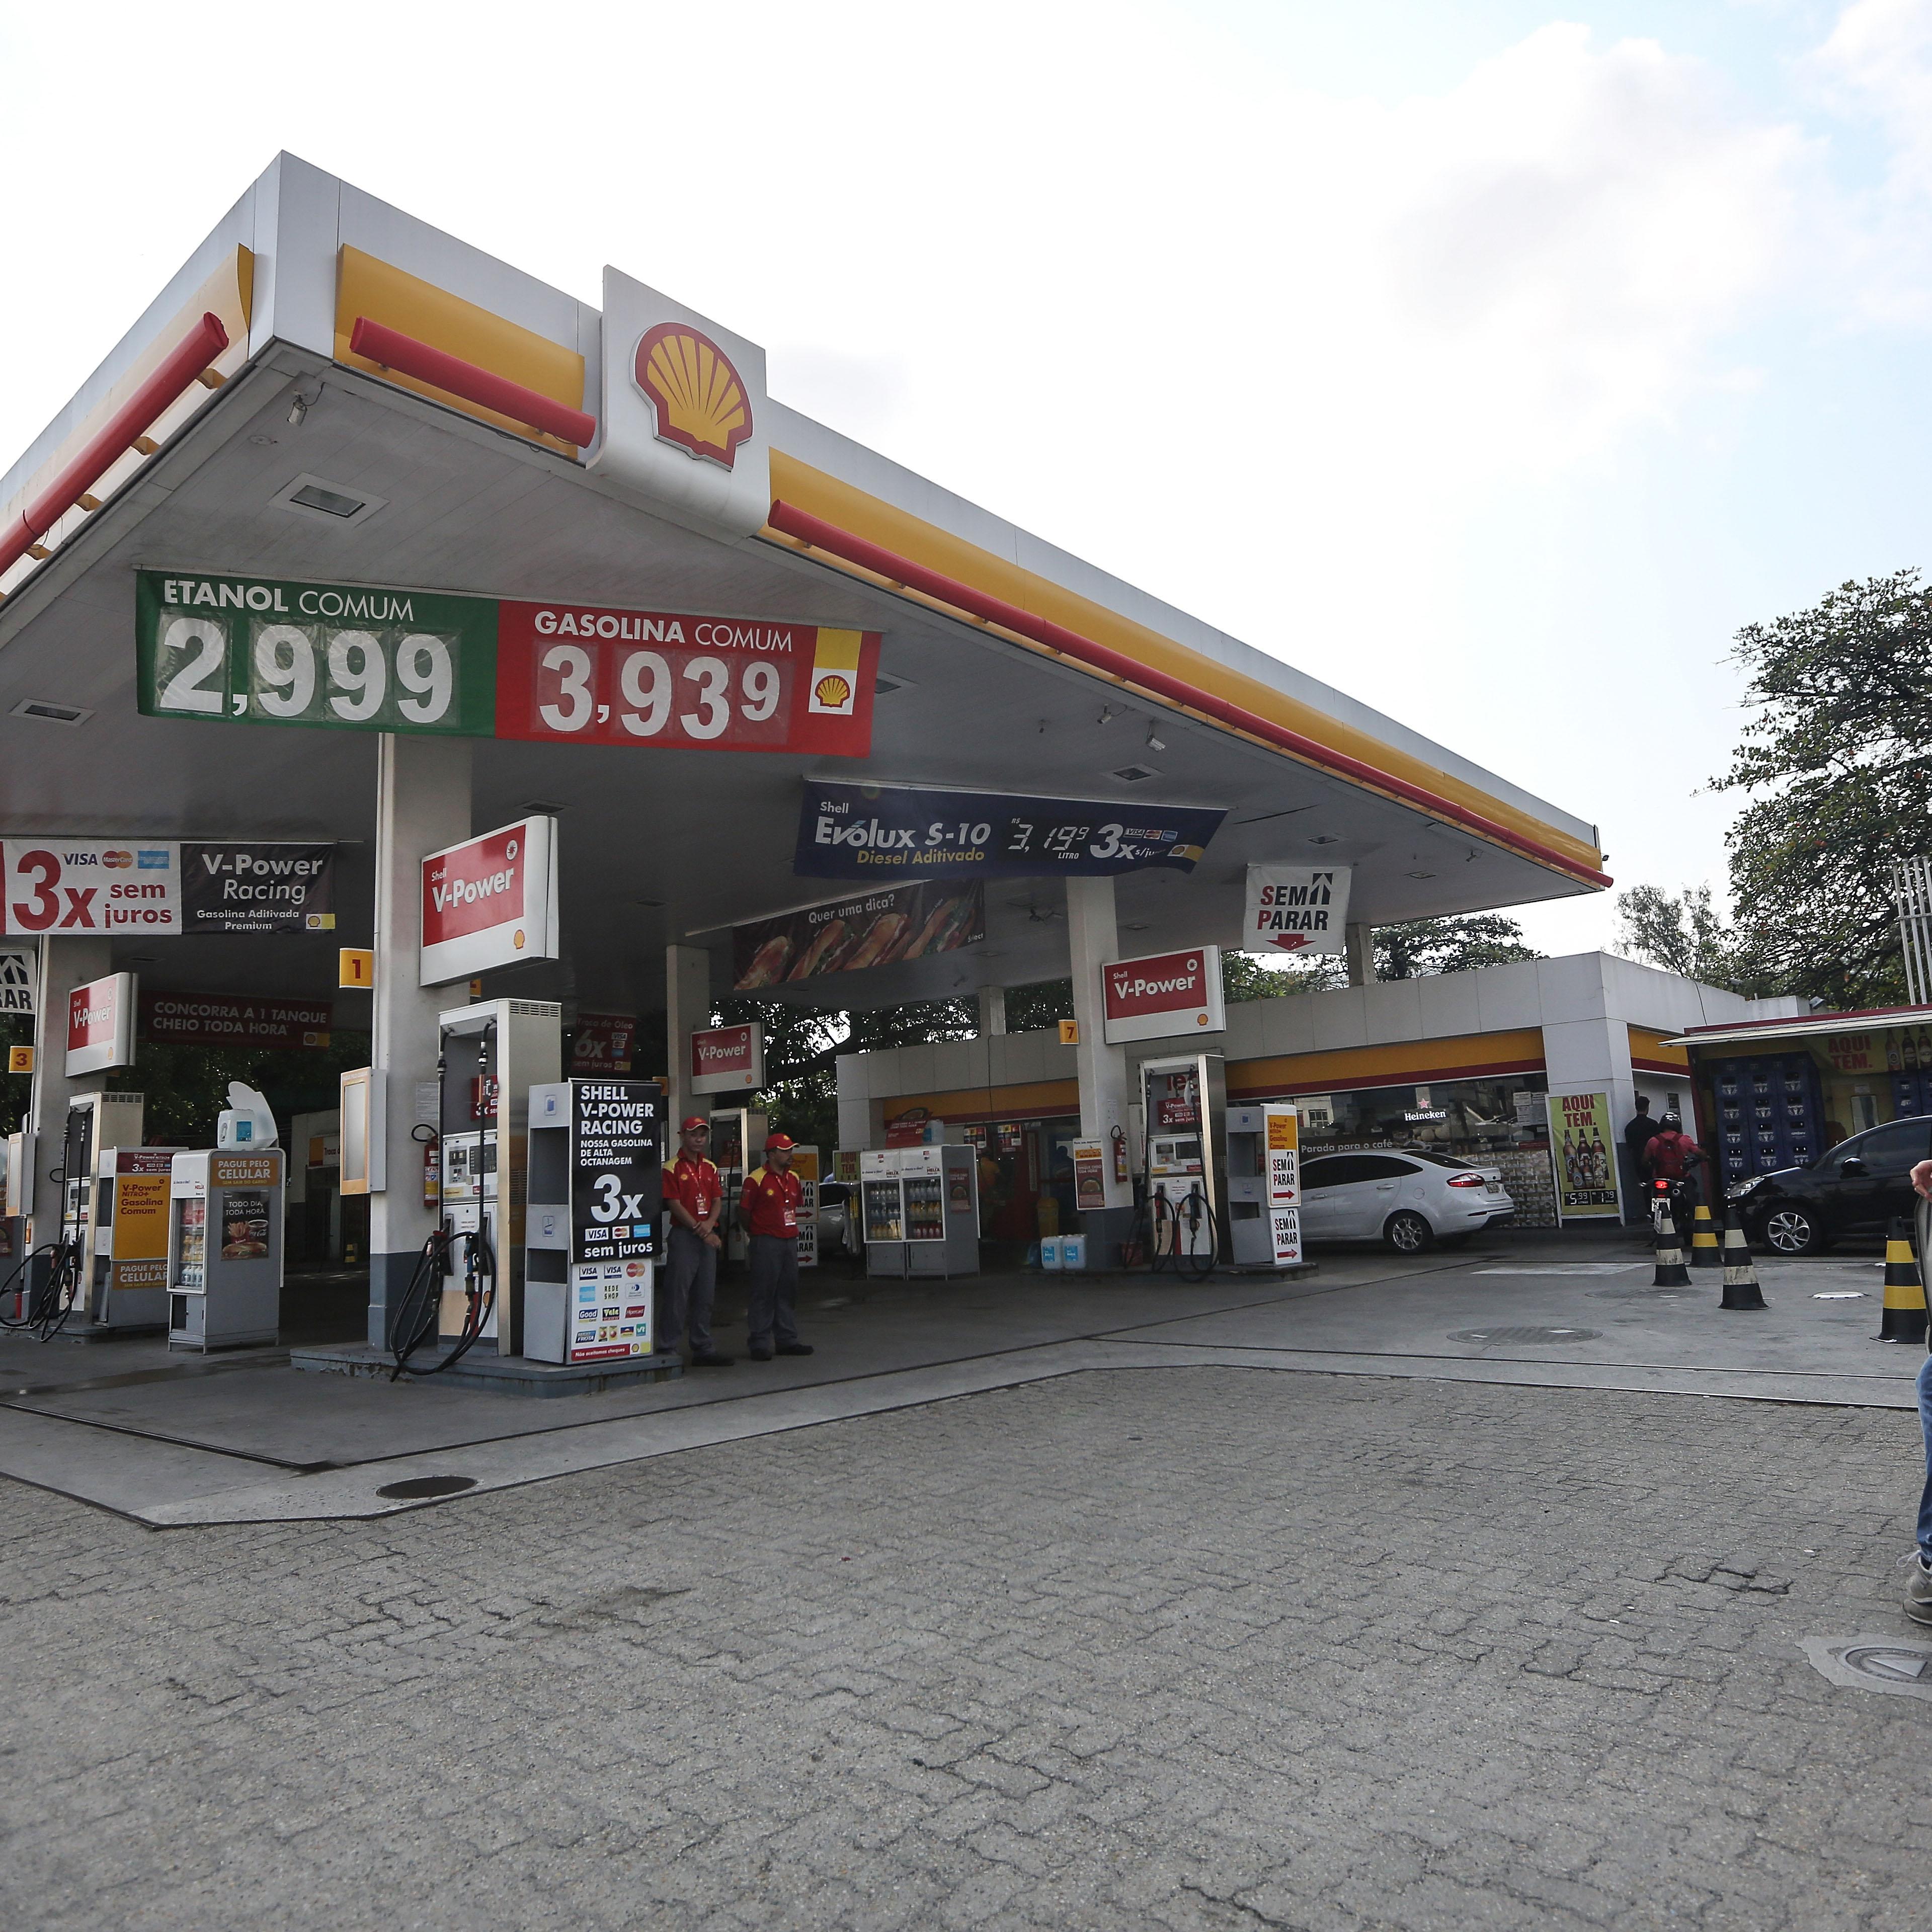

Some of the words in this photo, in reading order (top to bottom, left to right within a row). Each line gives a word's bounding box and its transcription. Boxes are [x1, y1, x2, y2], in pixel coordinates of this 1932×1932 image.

[164, 580, 288, 612] ETANOL
[299, 590, 414, 621] COMUM
[535, 611, 685, 643] GASOLINA
[695, 624, 792, 652] COMUM
[159, 617, 452, 723] 2,999
[539, 645, 780, 740] 3,939
[820, 801, 848, 813] Shell
[925, 823, 991, 845] S-10
[1090, 824, 1137, 859] 3x
[62, 853, 98, 865] VISA
[857, 849, 908, 864] Diesel
[912, 847, 985, 864] Aditivado
[202, 854, 323, 875] V-Power
[431, 867, 447, 881] Shell
[13, 849, 98, 931] 3x
[110, 884, 166, 899] sem
[223, 879, 306, 905] Racing
[432, 867, 514, 912] V-Power
[1260, 885, 1308, 906] SEM
[105, 903, 173, 928] juros
[197, 910, 245, 918] Gasolina
[248, 909, 299, 918] Aditivada
[809, 909, 835, 924] Quer
[838, 903, 862, 918] uma
[865, 894, 895, 912] dica?
[225, 922, 272, 930] Premium
[1257, 910, 1329, 930] PARAR
[352, 959, 361, 979] 1
[1113, 971, 1128, 980] Shell
[1114, 976, 1196, 999] V-Power
[0, 989, 32, 1010] AR
[73, 1006, 111, 1029] V-Power
[154, 1002, 239, 1018] CONCORRA
[244, 1007, 254, 1019] A
[261, 1008, 265, 1019] 1
[272, 1009, 327, 1023] TANQUE
[153, 1017, 199, 1030] CHEIO
[204, 1020, 244, 1033] TODA
[1067, 1026, 1075, 1039] 7
[575, 1029, 607, 1058] 6x
[1828, 1035, 1872, 1053] AQUI
[16, 1053, 28, 1066] 3
[698, 1045, 746, 1061] V-Power
[592, 1060, 612, 1069] juros
[581, 1086, 628, 1100] SHELL
[580, 1103, 654, 1117] V-POWER
[1562, 1095, 1595, 1111] AQUI
[1163, 1114, 1173, 1123] 3x
[1405, 1110, 1446, 1121] Heineken
[1564, 1111, 1596, 1128] TEM.
[581, 1120, 643, 1135] RACING
[581, 1140, 609, 1148] NOSSA
[611, 1139, 653, 1147] GASOLINA
[1301, 1144, 1334, 1153] Parada
[1338, 1144, 1360, 1152] para
[1373, 1139, 1393, 1148] café
[132, 1163, 144, 1172] 3x
[581, 1157, 632, 1166] OCTANAGEM
[1273, 1159, 1286, 1171] SEM
[218, 1169, 271, 1179] CELULAR
[1273, 1174, 1295, 1186] PARAR
[591, 1174, 643, 1223] 3x
[1275, 1218, 1289, 1231] SEM
[588, 1229, 607, 1239] VISA
[1277, 1232, 1298, 1245] PARAR
[585, 1246, 614, 1258] sem
[618, 1241, 653, 1258] juros
[580, 1309, 597, 1318] Good
